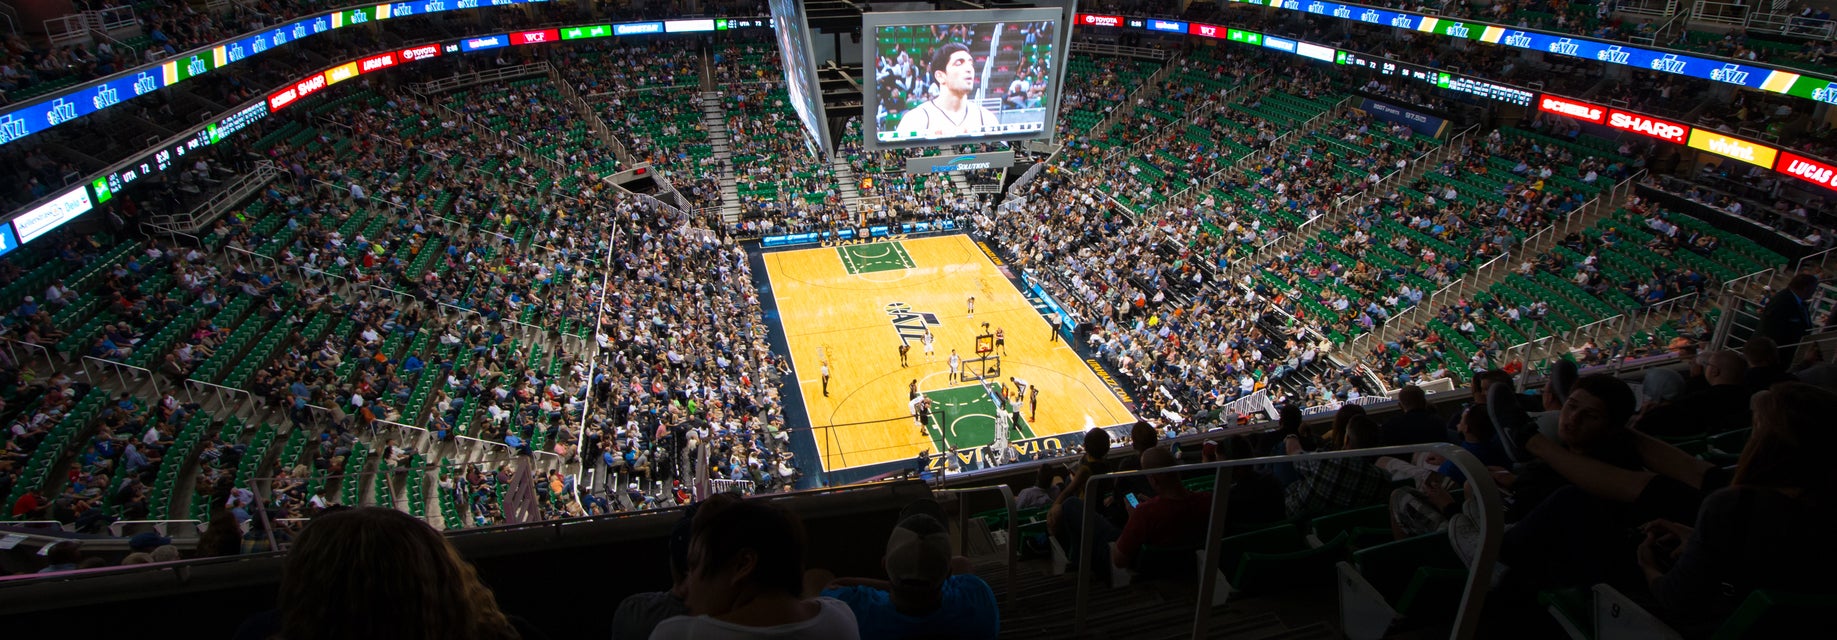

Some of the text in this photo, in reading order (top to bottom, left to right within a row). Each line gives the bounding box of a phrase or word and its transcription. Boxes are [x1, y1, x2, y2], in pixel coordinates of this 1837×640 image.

[1095, 16, 1118, 24] TOYOTA
[524, 33, 545, 42] WCF
[412, 46, 437, 56] TOYOTA
[1597, 45, 1631, 65] JAZZ
[1651, 53, 1687, 75] JAZZ
[1709, 63, 1750, 86] JAZZ
[1541, 98, 1602, 121] SCHEELS
[140, 163, 151, 175] 72
[1787, 159, 1833, 184] LUCAS
[122, 170, 137, 184] UTA
[821, 238, 865, 248] UTAH
[871, 233, 909, 244] JAZZ
[1610, 603, 1621, 618] 9
